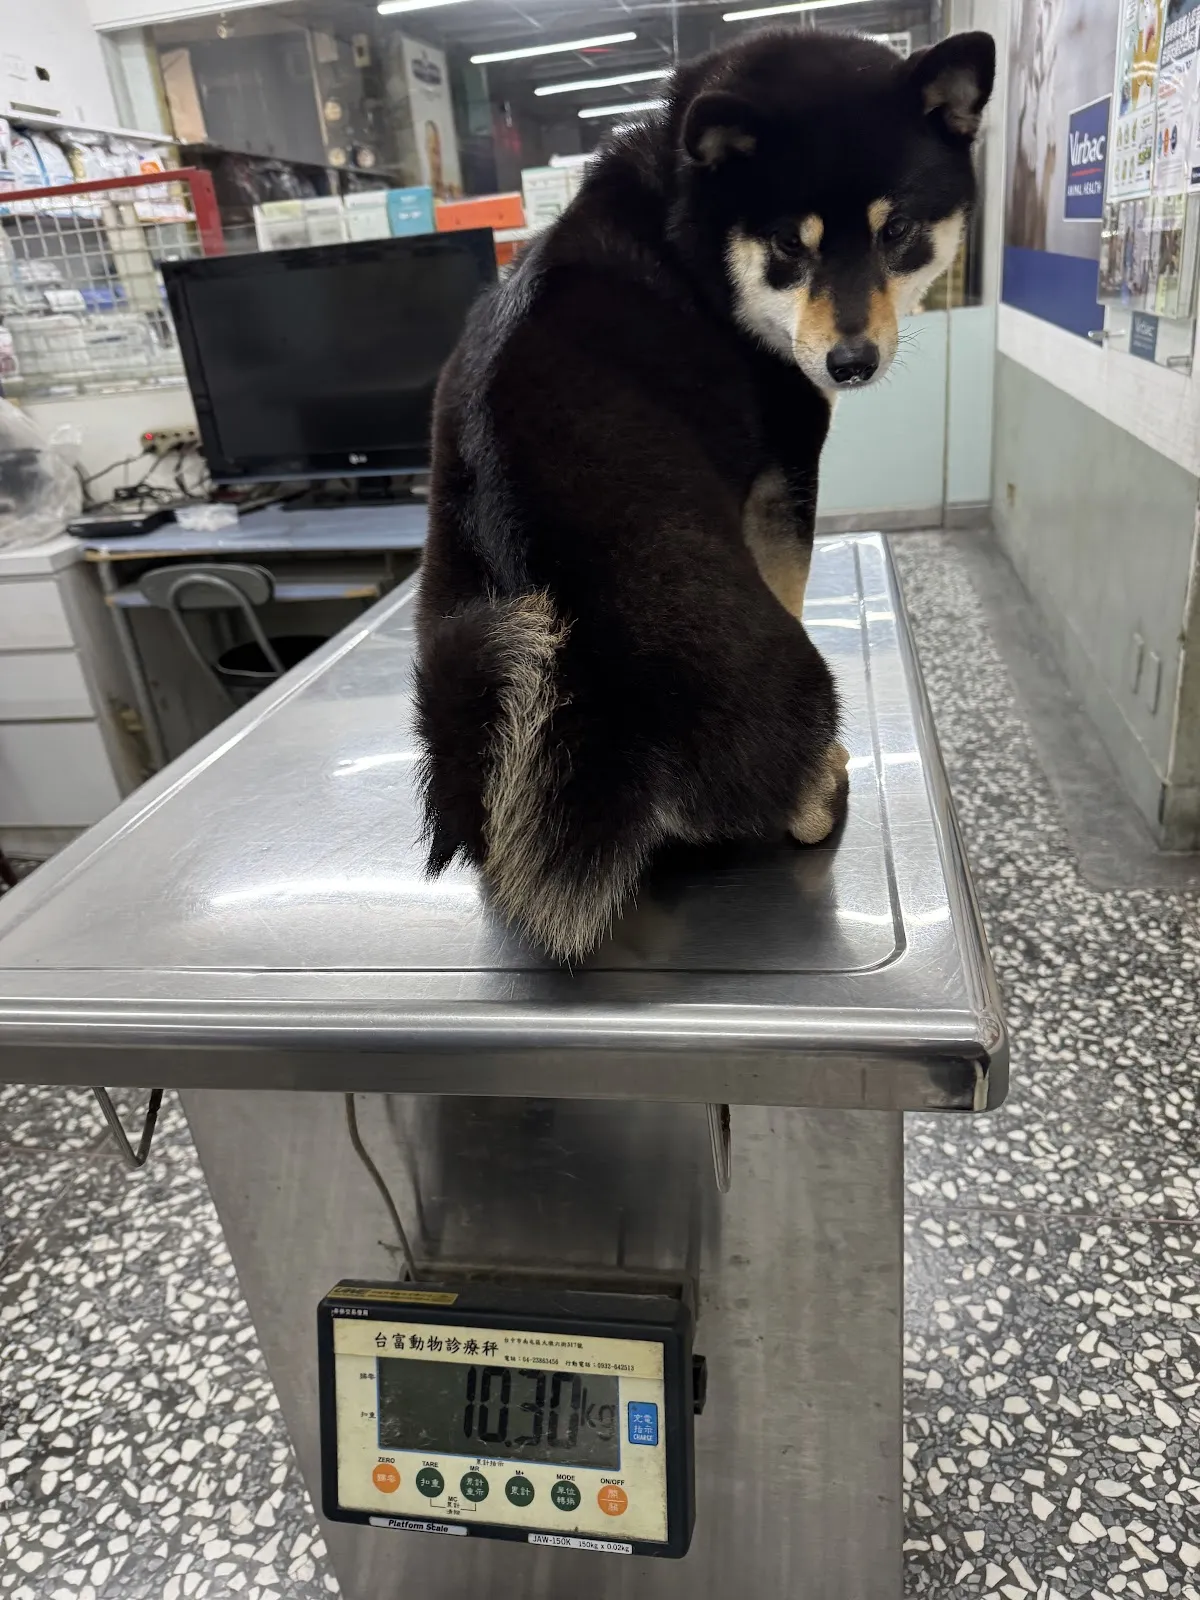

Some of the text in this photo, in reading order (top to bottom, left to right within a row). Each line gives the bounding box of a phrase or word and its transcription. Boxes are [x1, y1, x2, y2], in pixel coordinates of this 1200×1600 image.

[1069, 130, 1106, 167] Virbac
[1067, 180, 1102, 197] ANIMAL HEALTH
[375, 1331, 499, 1357] 台富動物診療秤
[633, 1433, 653, 1442] CHARGE
[377, 1456, 396, 1464] ZERO
[421, 1460, 439, 1468] TARE
[556, 1473, 576, 1481] MODE
[600, 1478, 625, 1486] ON/OFF
[420, 1478, 440, 1488] 扣重
[510, 1486, 531, 1496] 累計
[388, 1519, 449, 1533] Platform Scale
[533, 1535, 571, 1546] JAW-150K
[578, 1540, 599, 1549] 150kg
[606, 1543, 630, 1553] 0.02kg
